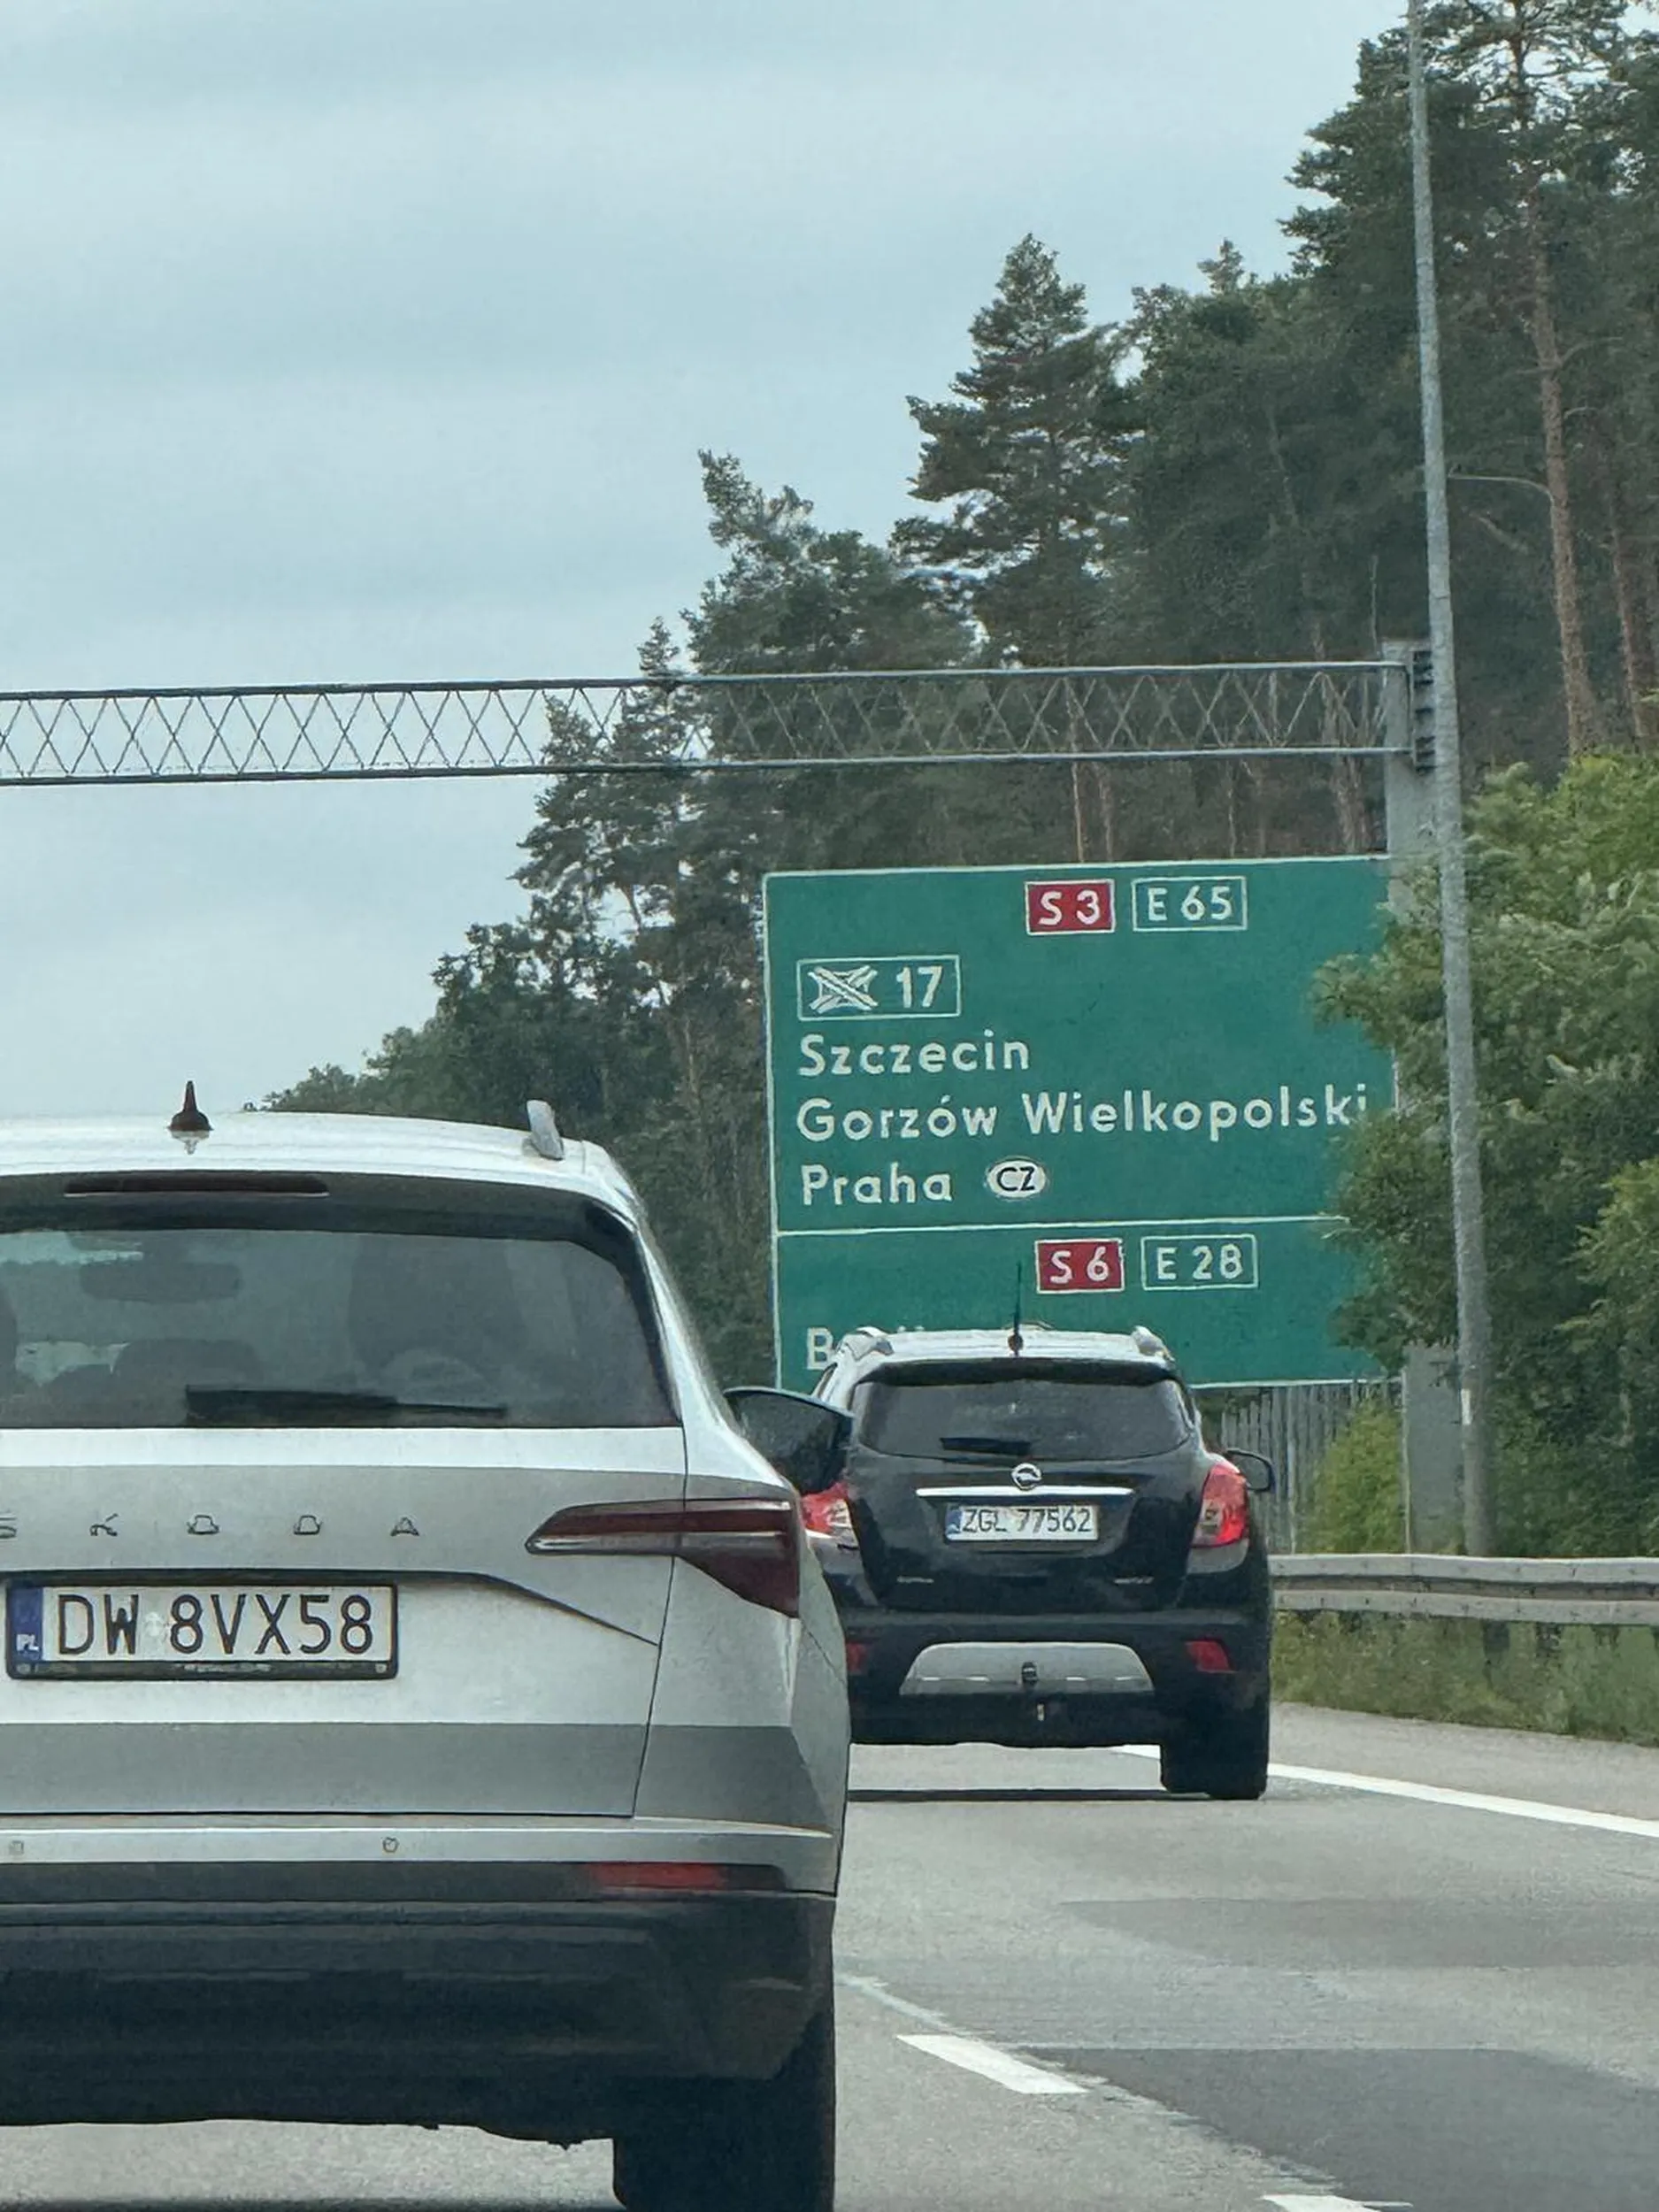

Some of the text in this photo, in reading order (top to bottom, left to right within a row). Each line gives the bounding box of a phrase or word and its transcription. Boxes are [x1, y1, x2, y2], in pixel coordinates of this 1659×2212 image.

[1038, 889, 1102, 925] S 3
[1148, 886, 1233, 921] E 65
[896, 966, 943, 1008] 17
[798, 1029, 1030, 1076] Szczecin
[797, 1083, 1366, 1141] Gorzów Wielkopolski
[802, 1162, 1035, 1205] Praha CZ
[1049, 1246, 1110, 1284] S 6
[1156, 1243, 1243, 1280] E 28
[962, 1509, 1092, 1532] ZGL 77562
[16, 1633, 41, 1652] PL
[58, 1594, 373, 1655] DW 8VX58
